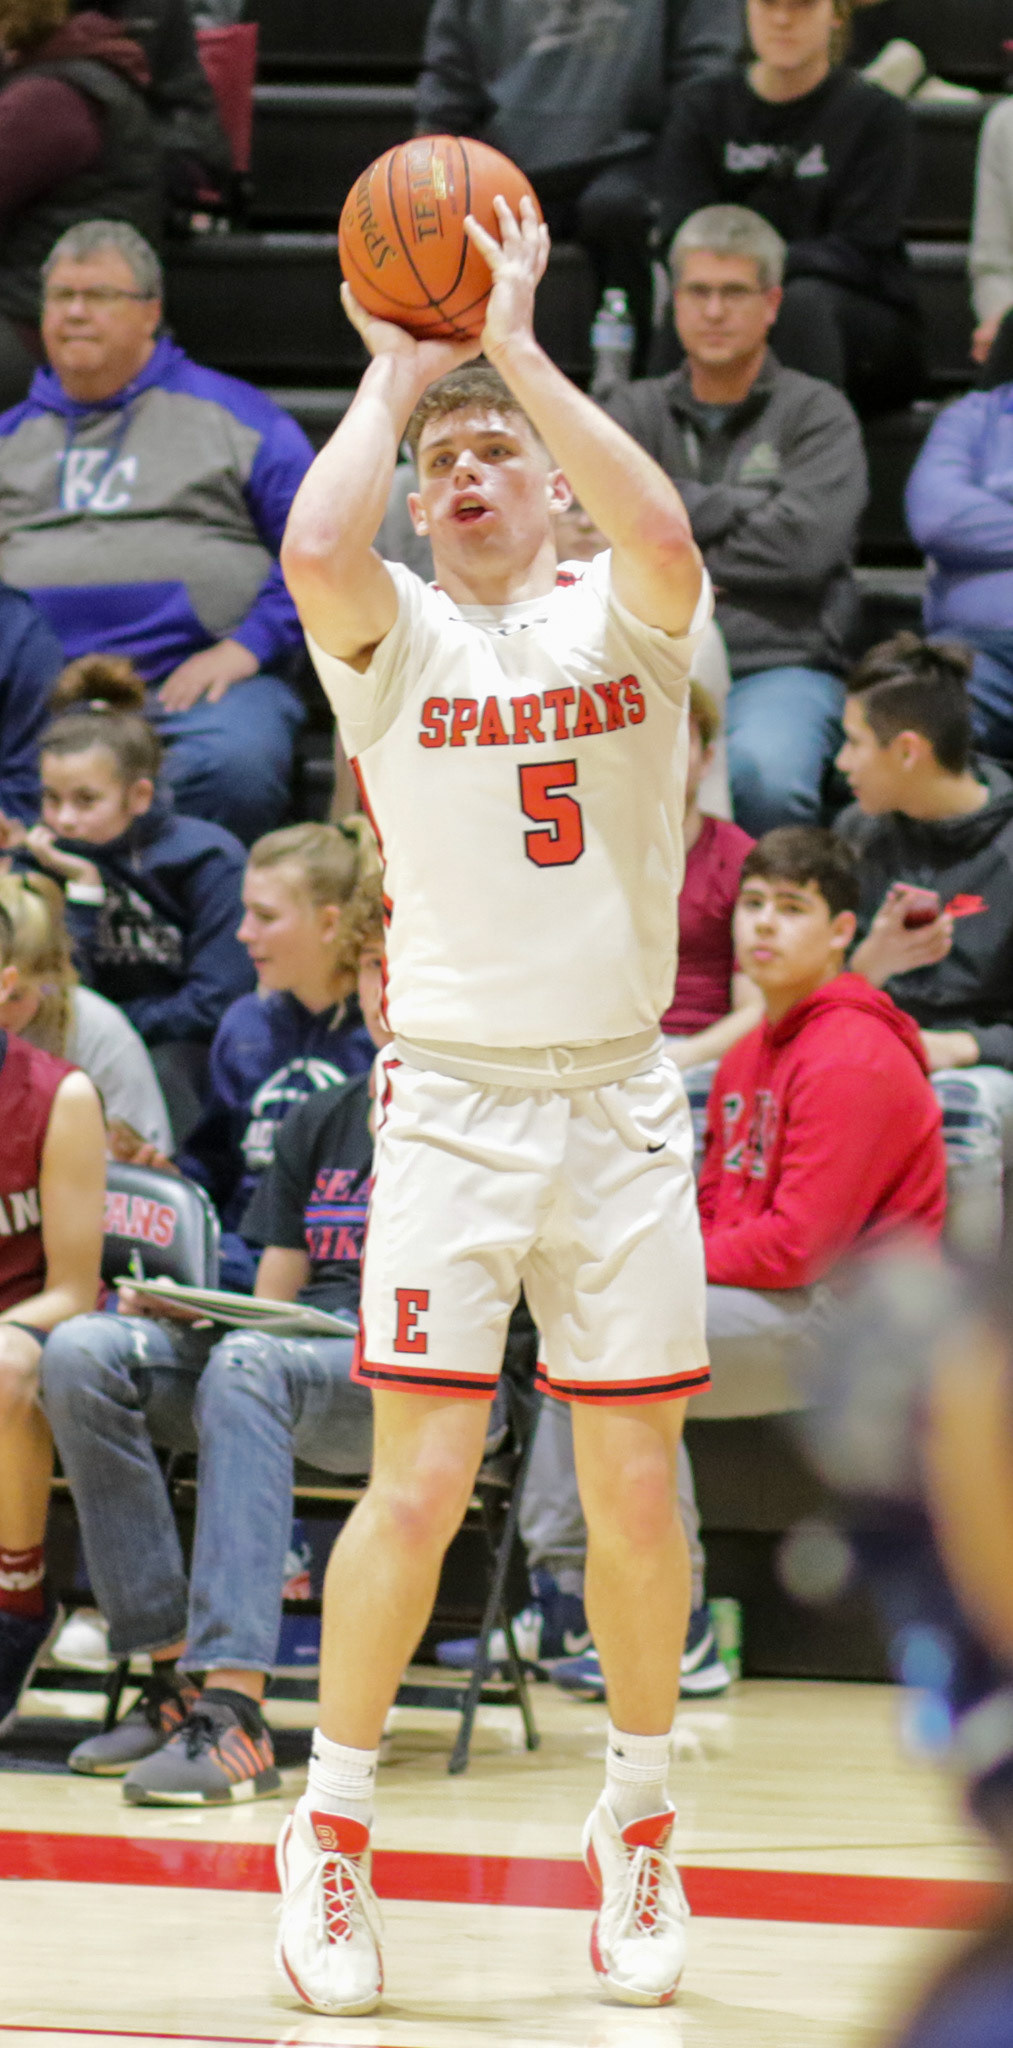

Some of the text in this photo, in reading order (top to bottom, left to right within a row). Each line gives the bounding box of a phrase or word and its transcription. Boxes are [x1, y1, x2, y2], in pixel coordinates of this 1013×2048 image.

[56, 447, 137, 512] KC
[418, 673, 647, 748] SPARTANS
[517, 758, 585, 868] 5
[393, 1287, 430, 1354] E
